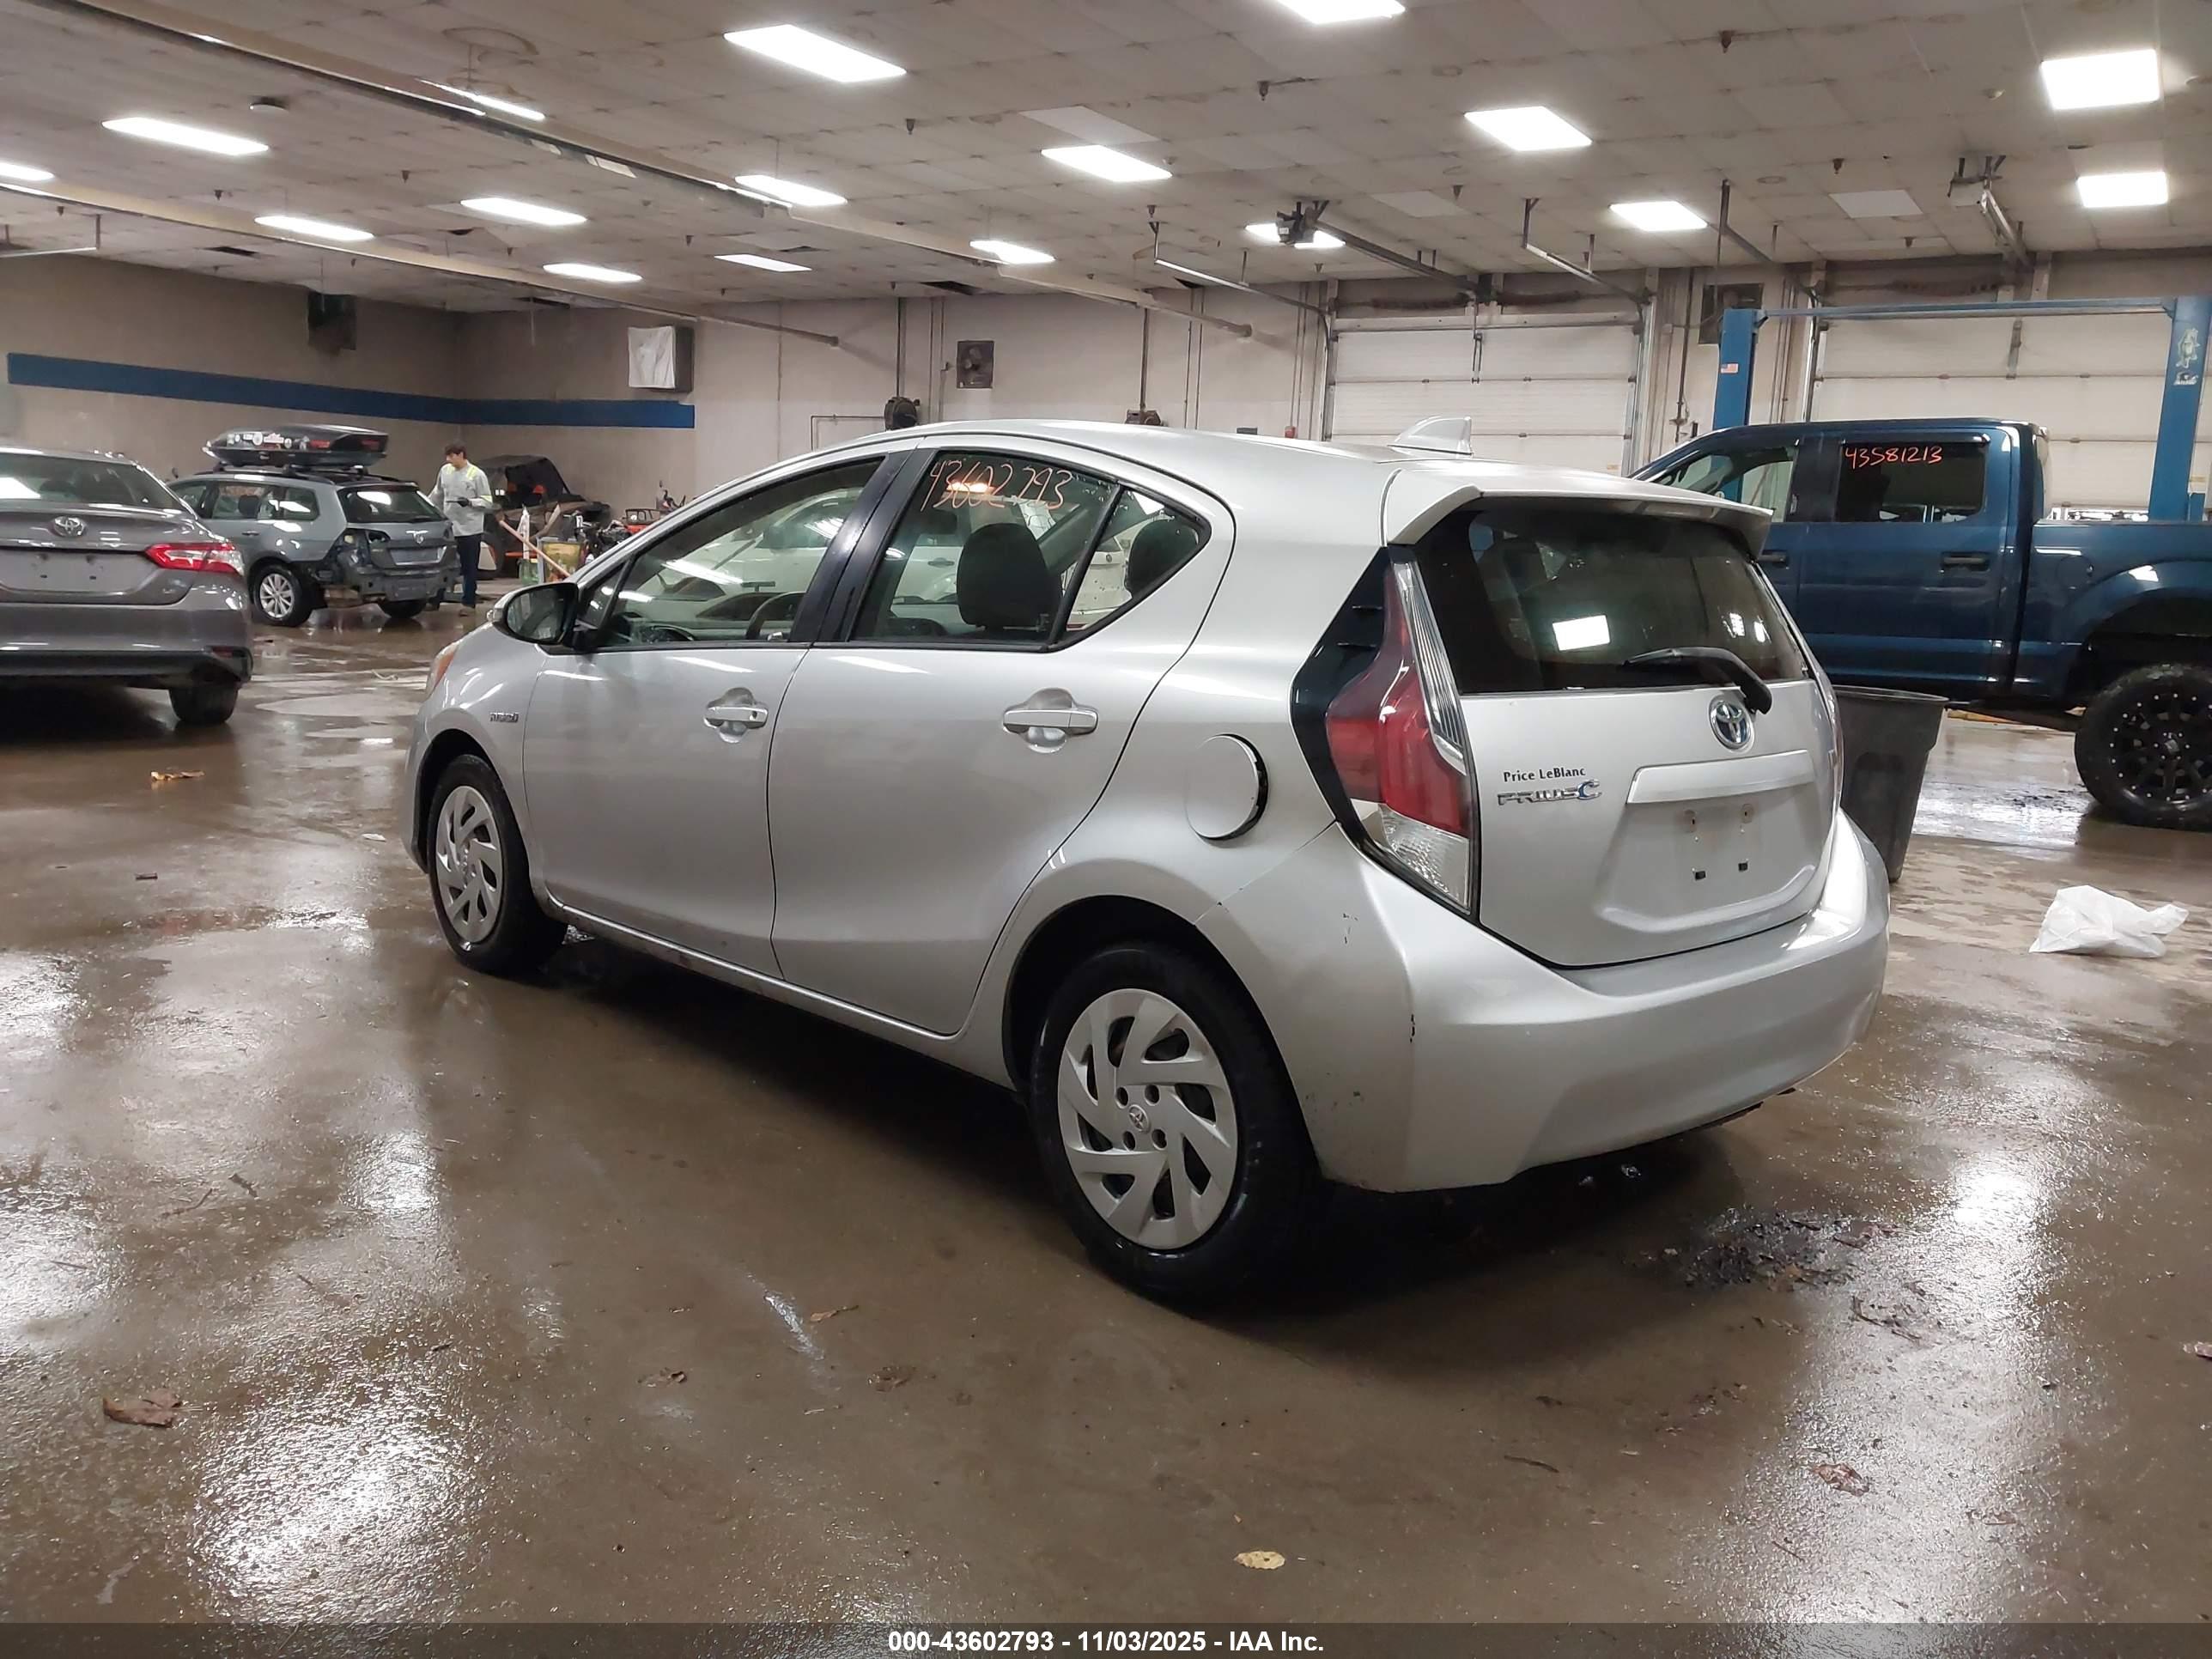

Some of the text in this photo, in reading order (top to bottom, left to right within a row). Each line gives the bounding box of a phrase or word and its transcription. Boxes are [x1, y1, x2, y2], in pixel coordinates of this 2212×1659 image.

[1844, 446, 1943, 470] 43581213
[921, 459, 1073, 512] 43602793
[1503, 767, 1587, 782] Price LeBlanc
